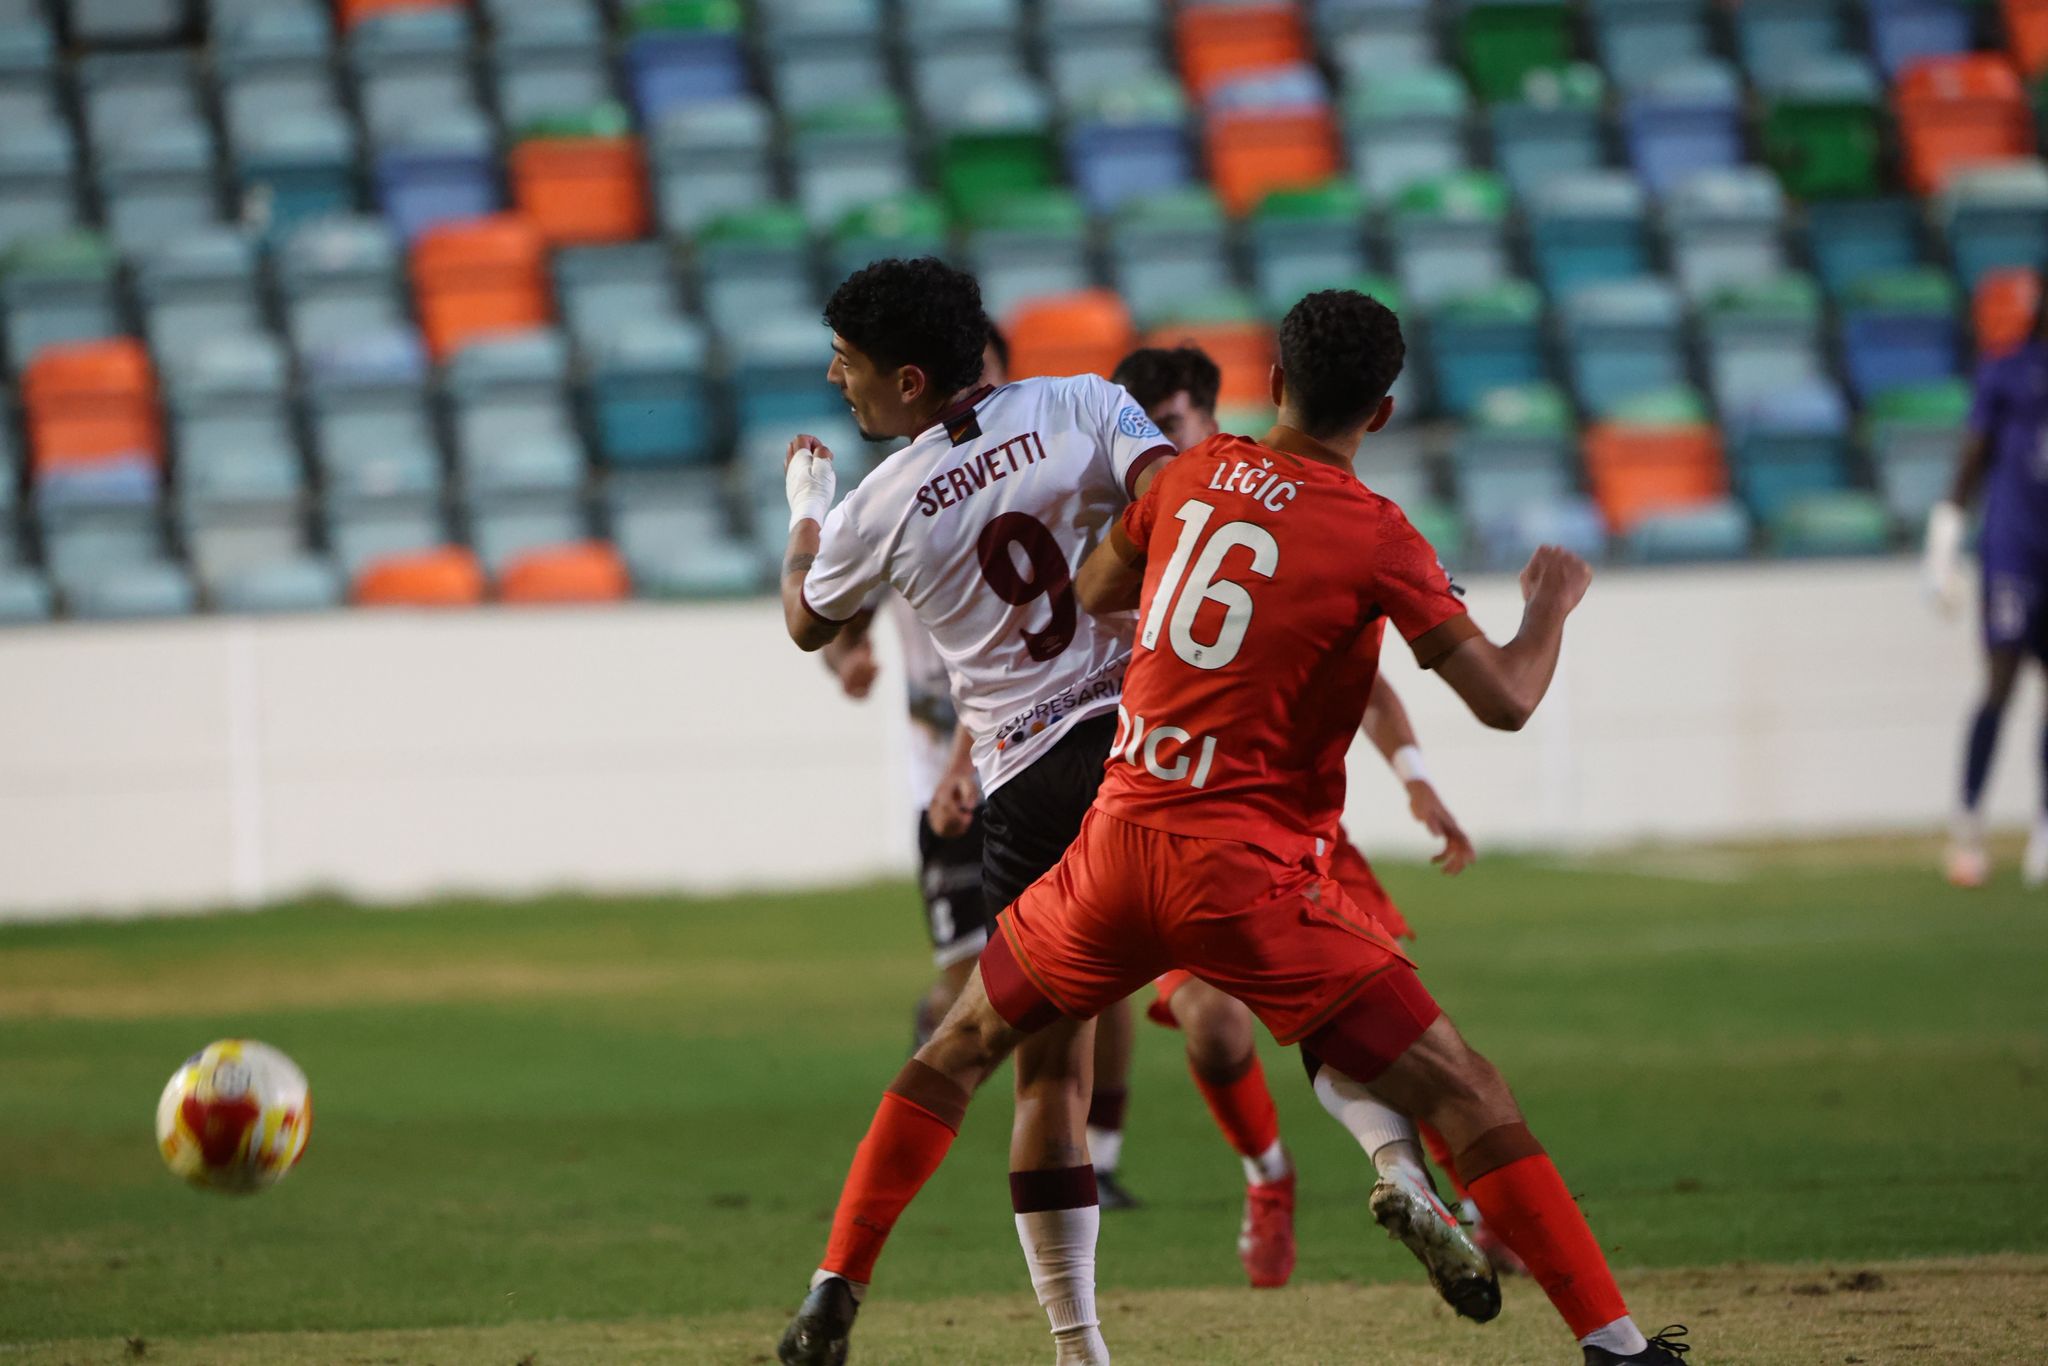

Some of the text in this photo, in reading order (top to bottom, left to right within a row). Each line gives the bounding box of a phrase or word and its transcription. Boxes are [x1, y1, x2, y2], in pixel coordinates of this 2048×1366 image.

[916, 431, 1047, 517] SERVETTI
[977, 511, 1077, 662] 9
[1140, 498, 1280, 670] 16
